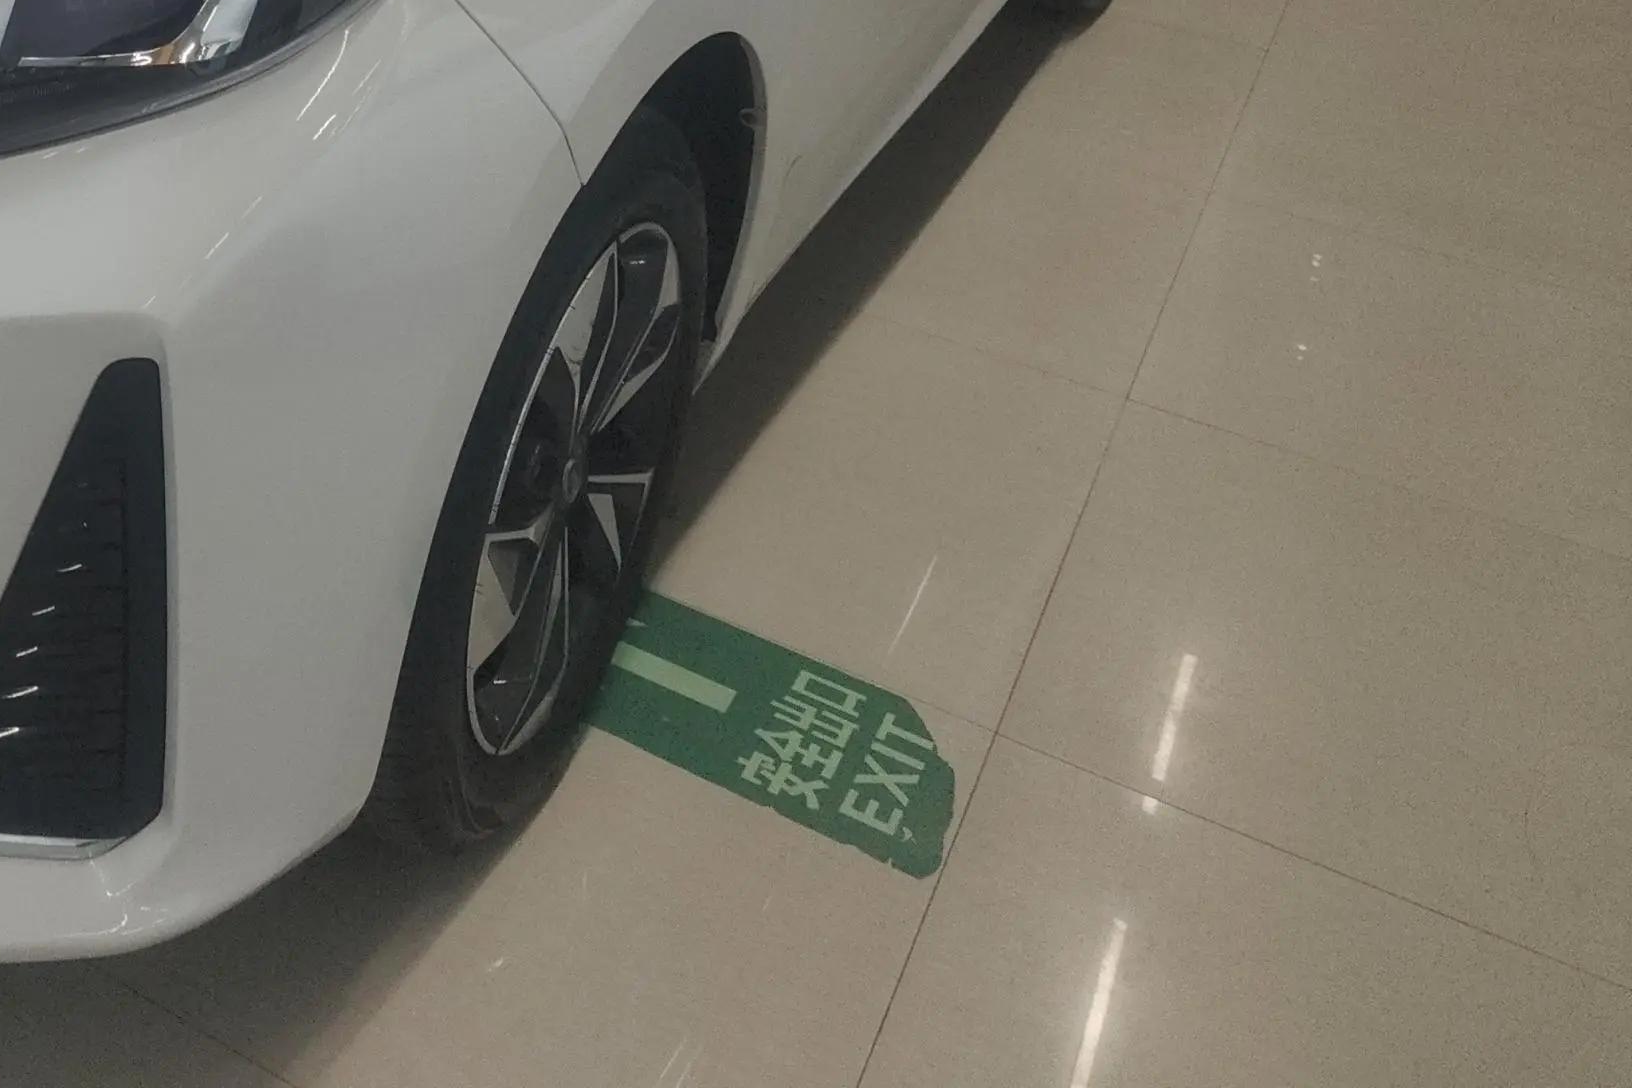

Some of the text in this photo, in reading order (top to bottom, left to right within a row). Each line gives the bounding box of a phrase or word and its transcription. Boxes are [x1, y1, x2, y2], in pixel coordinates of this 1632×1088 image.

[737, 670, 867, 810] 安全出口
[839, 712, 935, 836] EXIT
